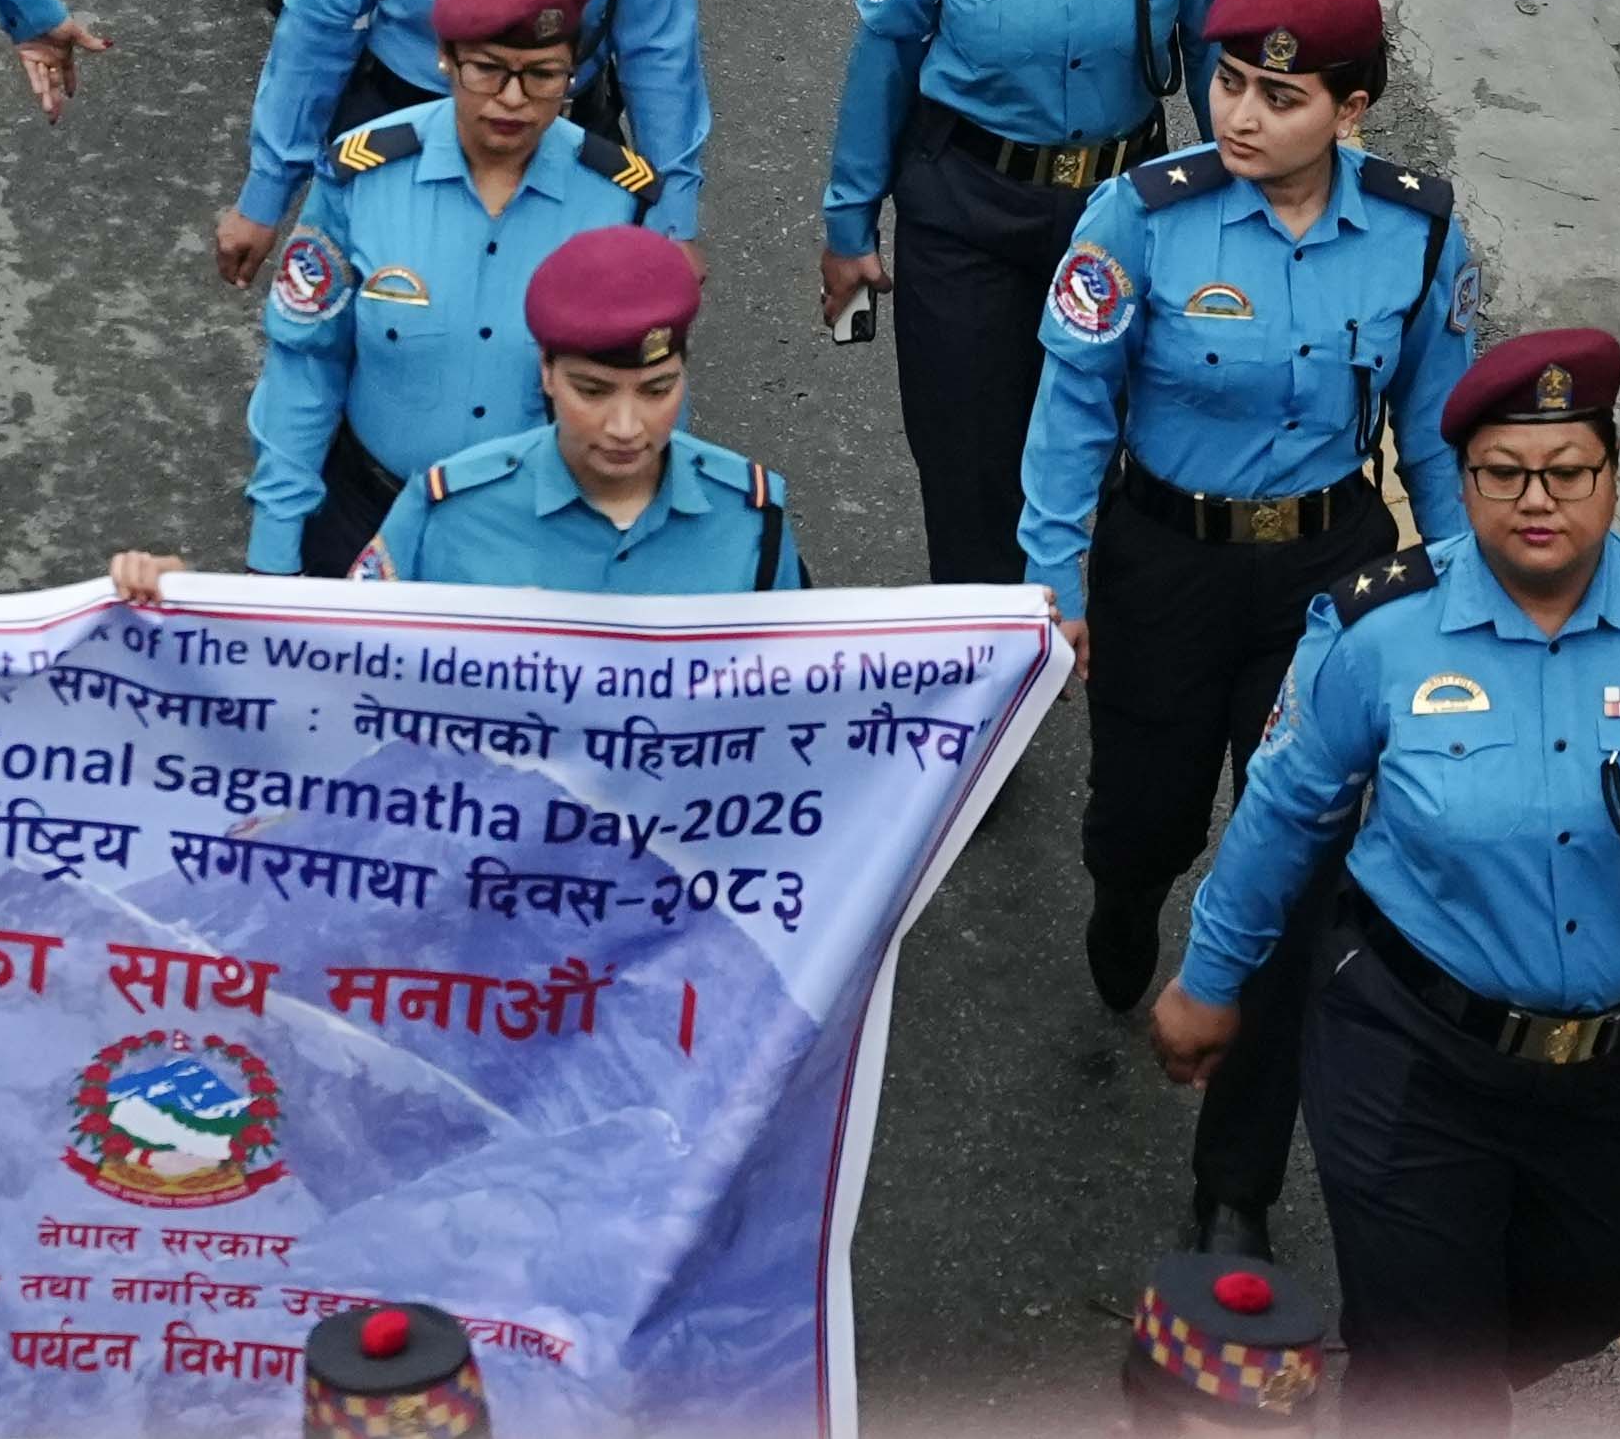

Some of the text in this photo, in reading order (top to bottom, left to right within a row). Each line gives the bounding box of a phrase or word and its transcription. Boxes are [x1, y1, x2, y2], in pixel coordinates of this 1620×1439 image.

[124, 622, 161, 660] of
[174, 629, 248, 667] The
[264, 636, 404, 682] World:
[419, 646, 583, 704] Identity
[596, 657, 673, 700] and
[688, 655, 791, 701] Pride
[805, 651, 848, 695] of
[48, 664, 275, 732] सगरमाथा
[353, 692, 560, 760] नेपालको
[584, 716, 764, 780] पहिचान
[788, 722, 826, 766] र
[155, 753, 520, 843] Sagarmatha
[544, 790, 822, 860] Day-2026
[170, 830, 437, 908] सगरमाथा
[107, 943, 279, 1018] साथ
[326, 957, 614, 1041] मनाऔं
[37, 1215, 297, 1266] नेपाल सरकार
[20, 1274, 91, 1302] तथा
[112, 1272, 262, 1312] नागरिक
[10, 1317, 307, 1384] पर्यटन विभाग
